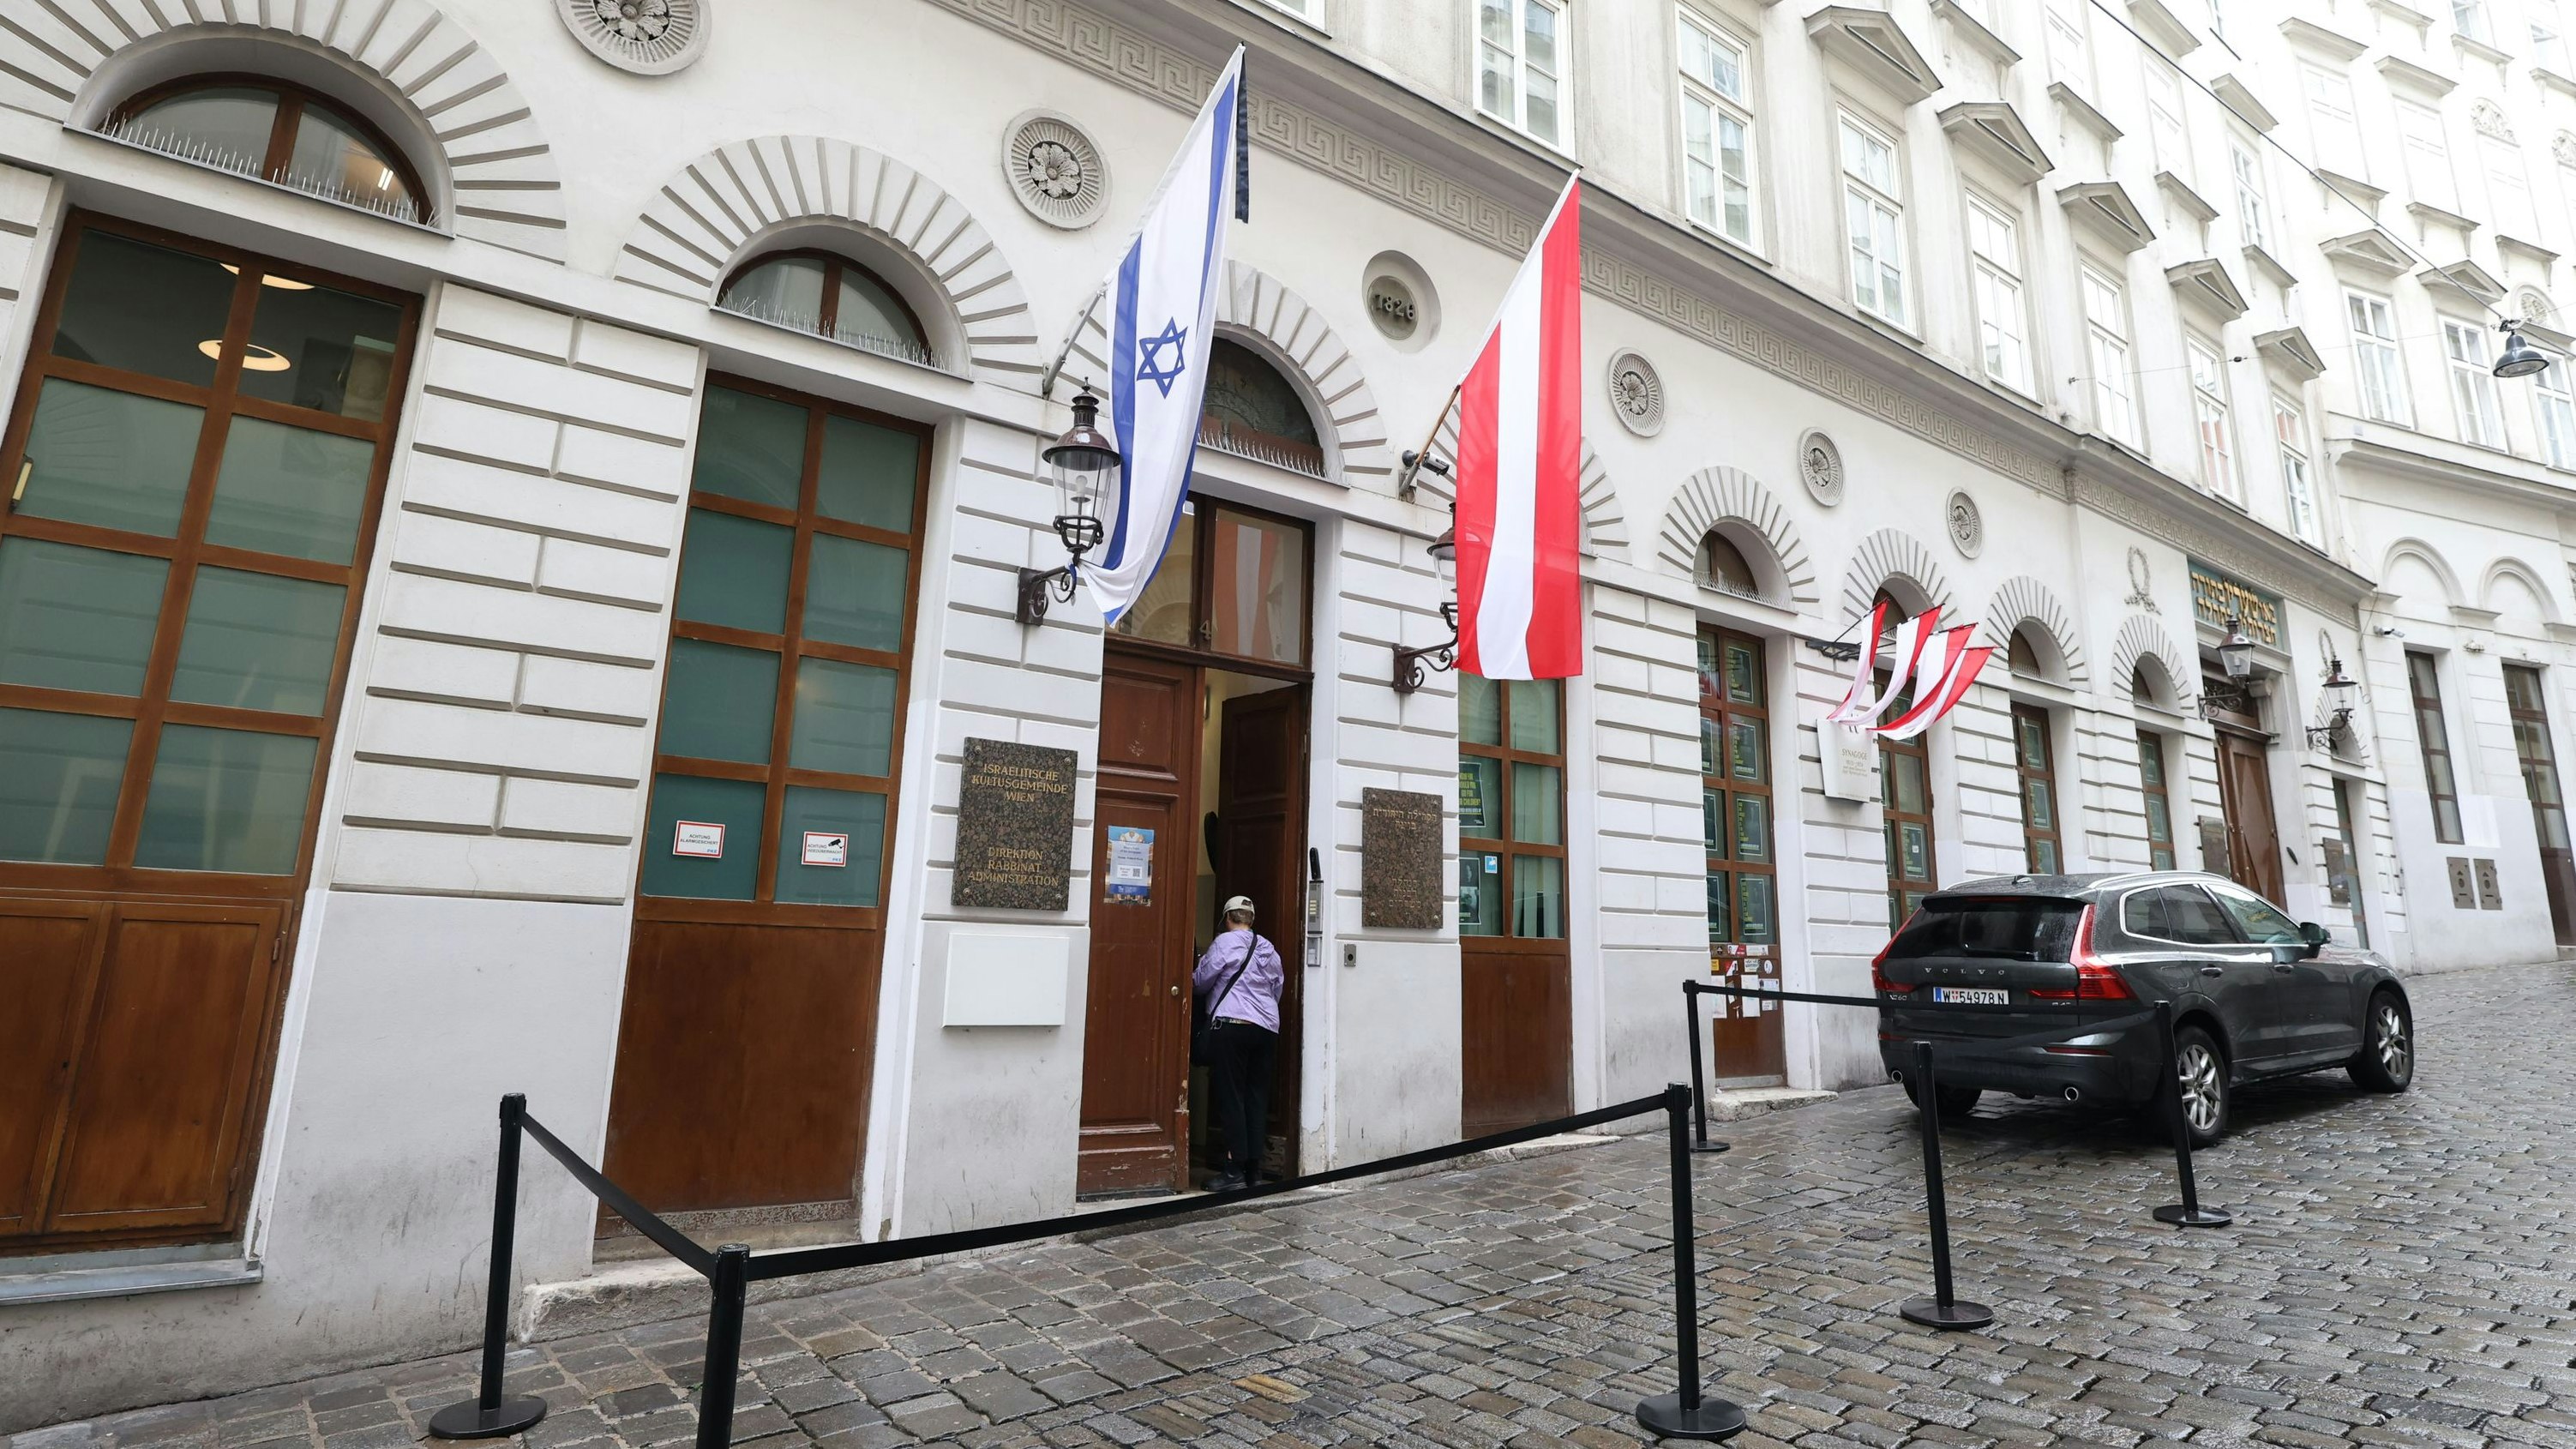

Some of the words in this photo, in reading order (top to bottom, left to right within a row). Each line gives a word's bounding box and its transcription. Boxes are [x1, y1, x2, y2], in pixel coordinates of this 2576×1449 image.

[1199, 619, 1211, 640] 4
[983, 763, 1060, 781] ISRAELITISCHE
[971, 775, 1068, 794] KULTUSGEMEINDE
[1006, 791, 1035, 803] WIEN
[988, 847, 1043, 860] DIREKTION
[988, 860, 1042, 873] RABBINAT
[967, 872, 1060, 887] ADMINISTRATION
[1924, 967, 2005, 976] VOLVO
[1943, 990, 1951, 1003] W
